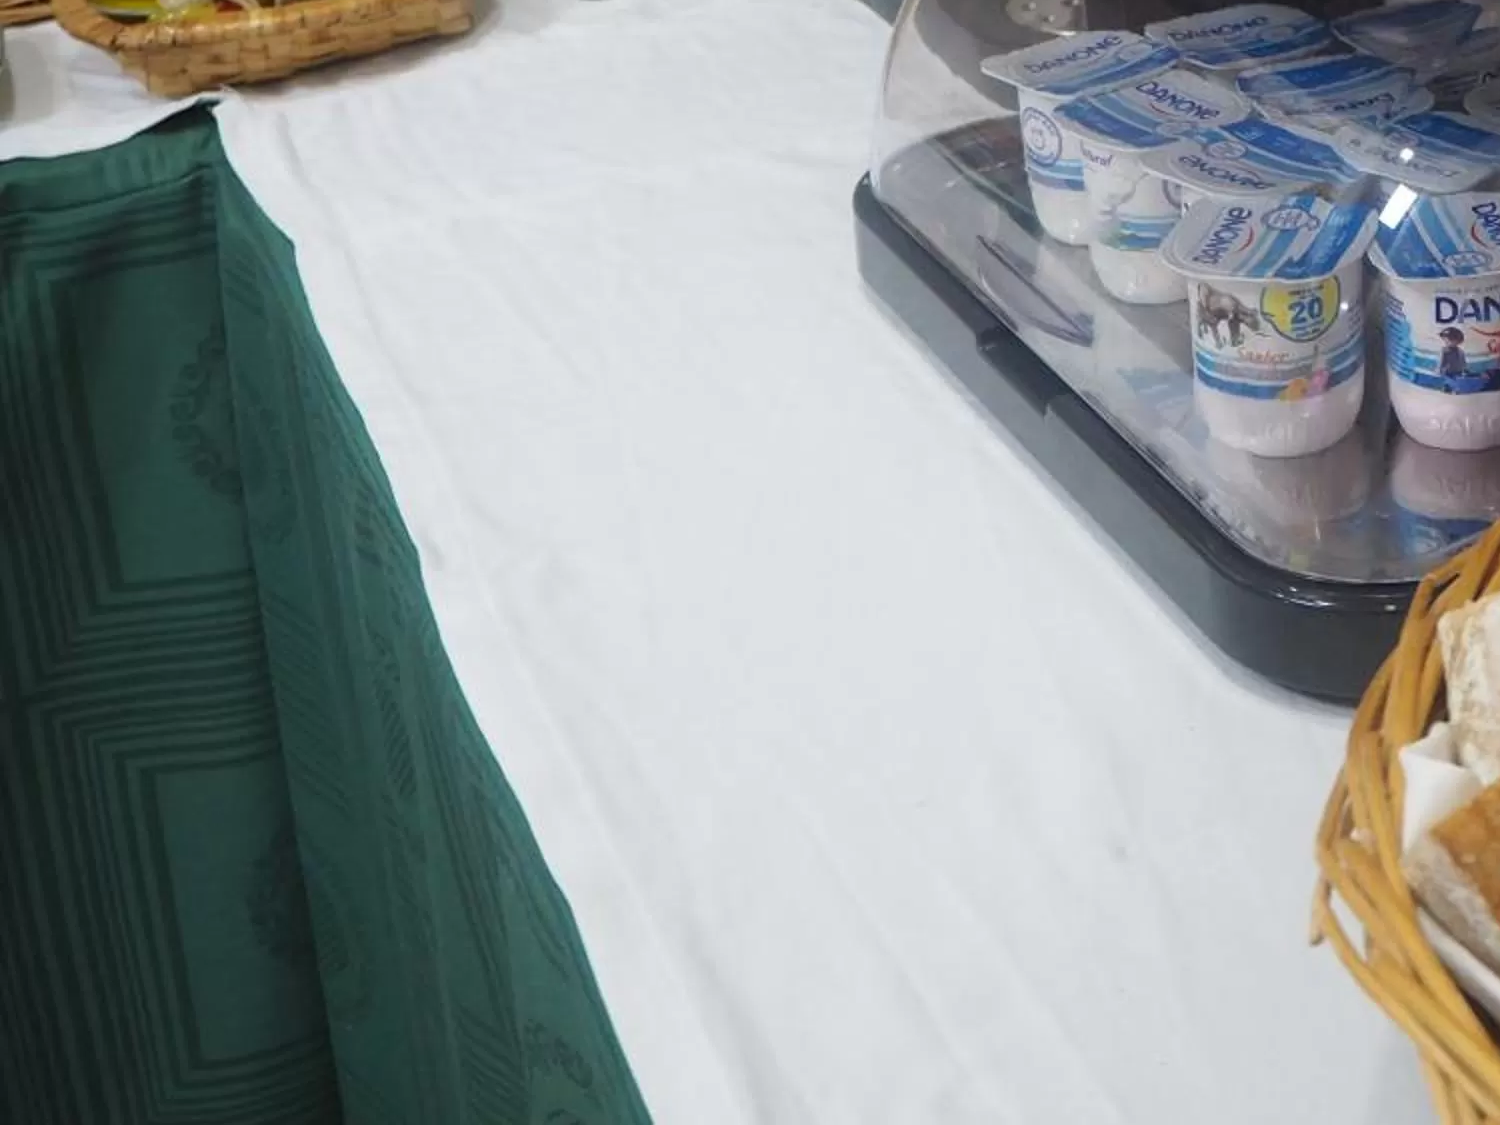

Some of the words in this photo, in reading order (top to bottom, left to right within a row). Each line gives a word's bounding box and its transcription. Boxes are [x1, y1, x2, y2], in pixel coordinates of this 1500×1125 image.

[1136, 81, 1221, 120] DANONE
[1192, 206, 1252, 265] DANONE
[1287, 295, 1324, 326] 20
